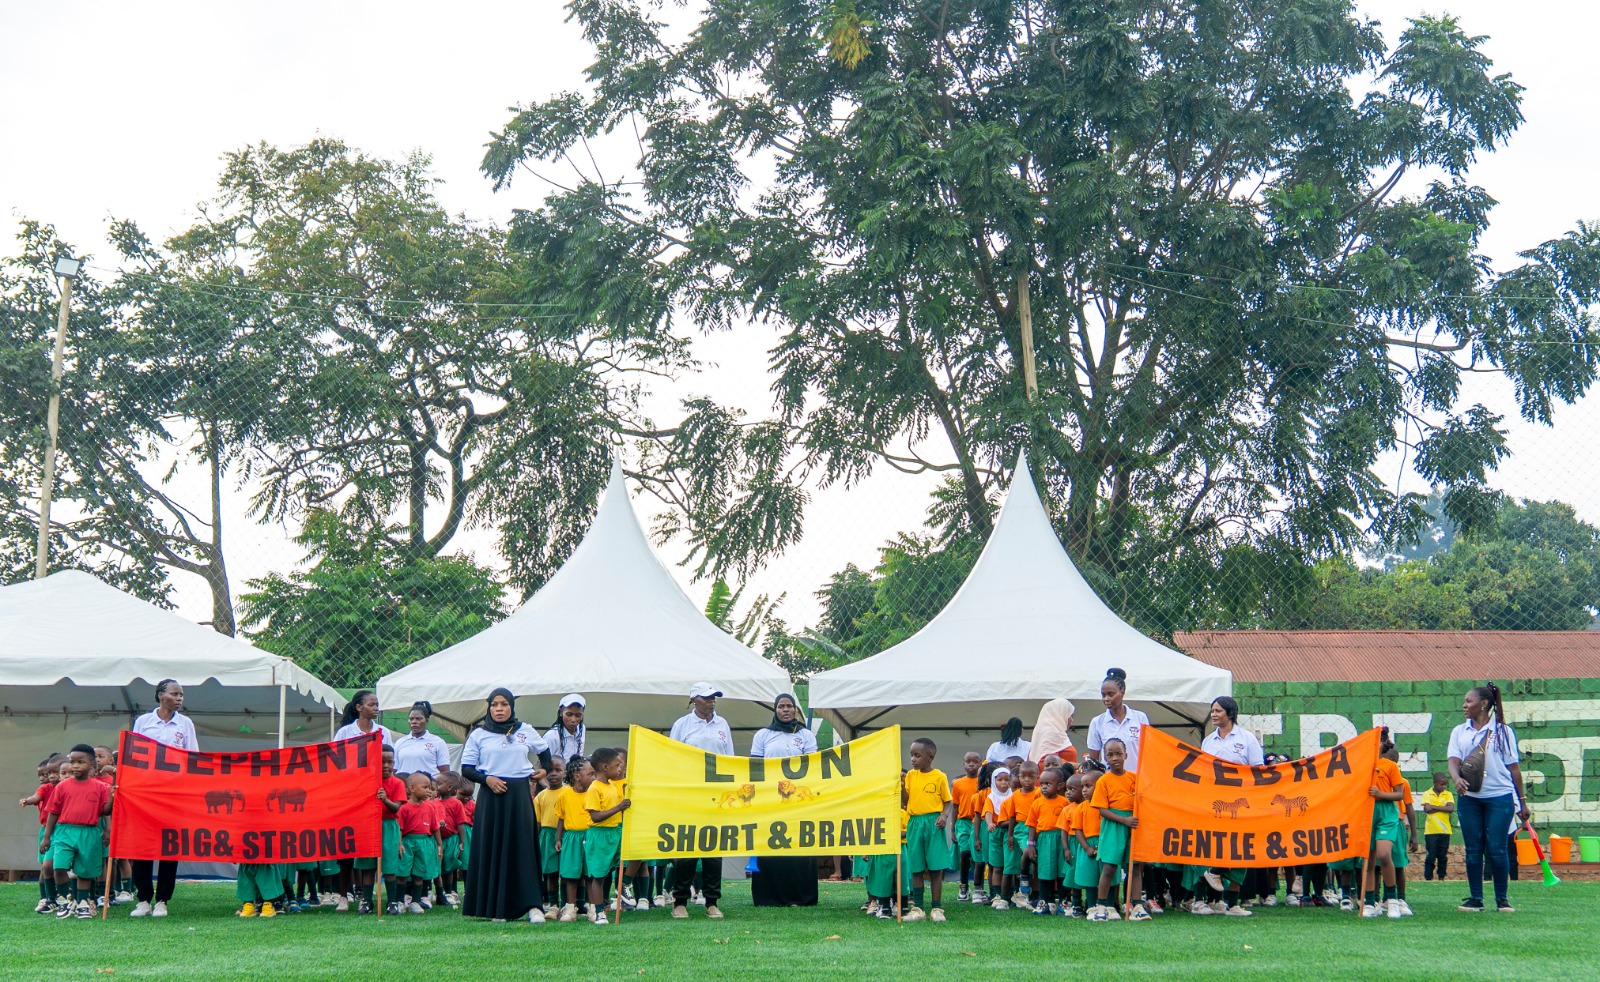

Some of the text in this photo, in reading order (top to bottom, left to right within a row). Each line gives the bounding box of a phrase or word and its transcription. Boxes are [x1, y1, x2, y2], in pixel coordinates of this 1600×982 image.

[121, 731, 376, 776] ELEPHANT
[704, 743, 852, 783] LION
[1172, 742, 1352, 787] ZEBRA
[242, 826, 357, 860] STRONG
[657, 818, 886, 852] SHORT & BRAVE
[1162, 823, 1349, 861] GENTLE & SURE
